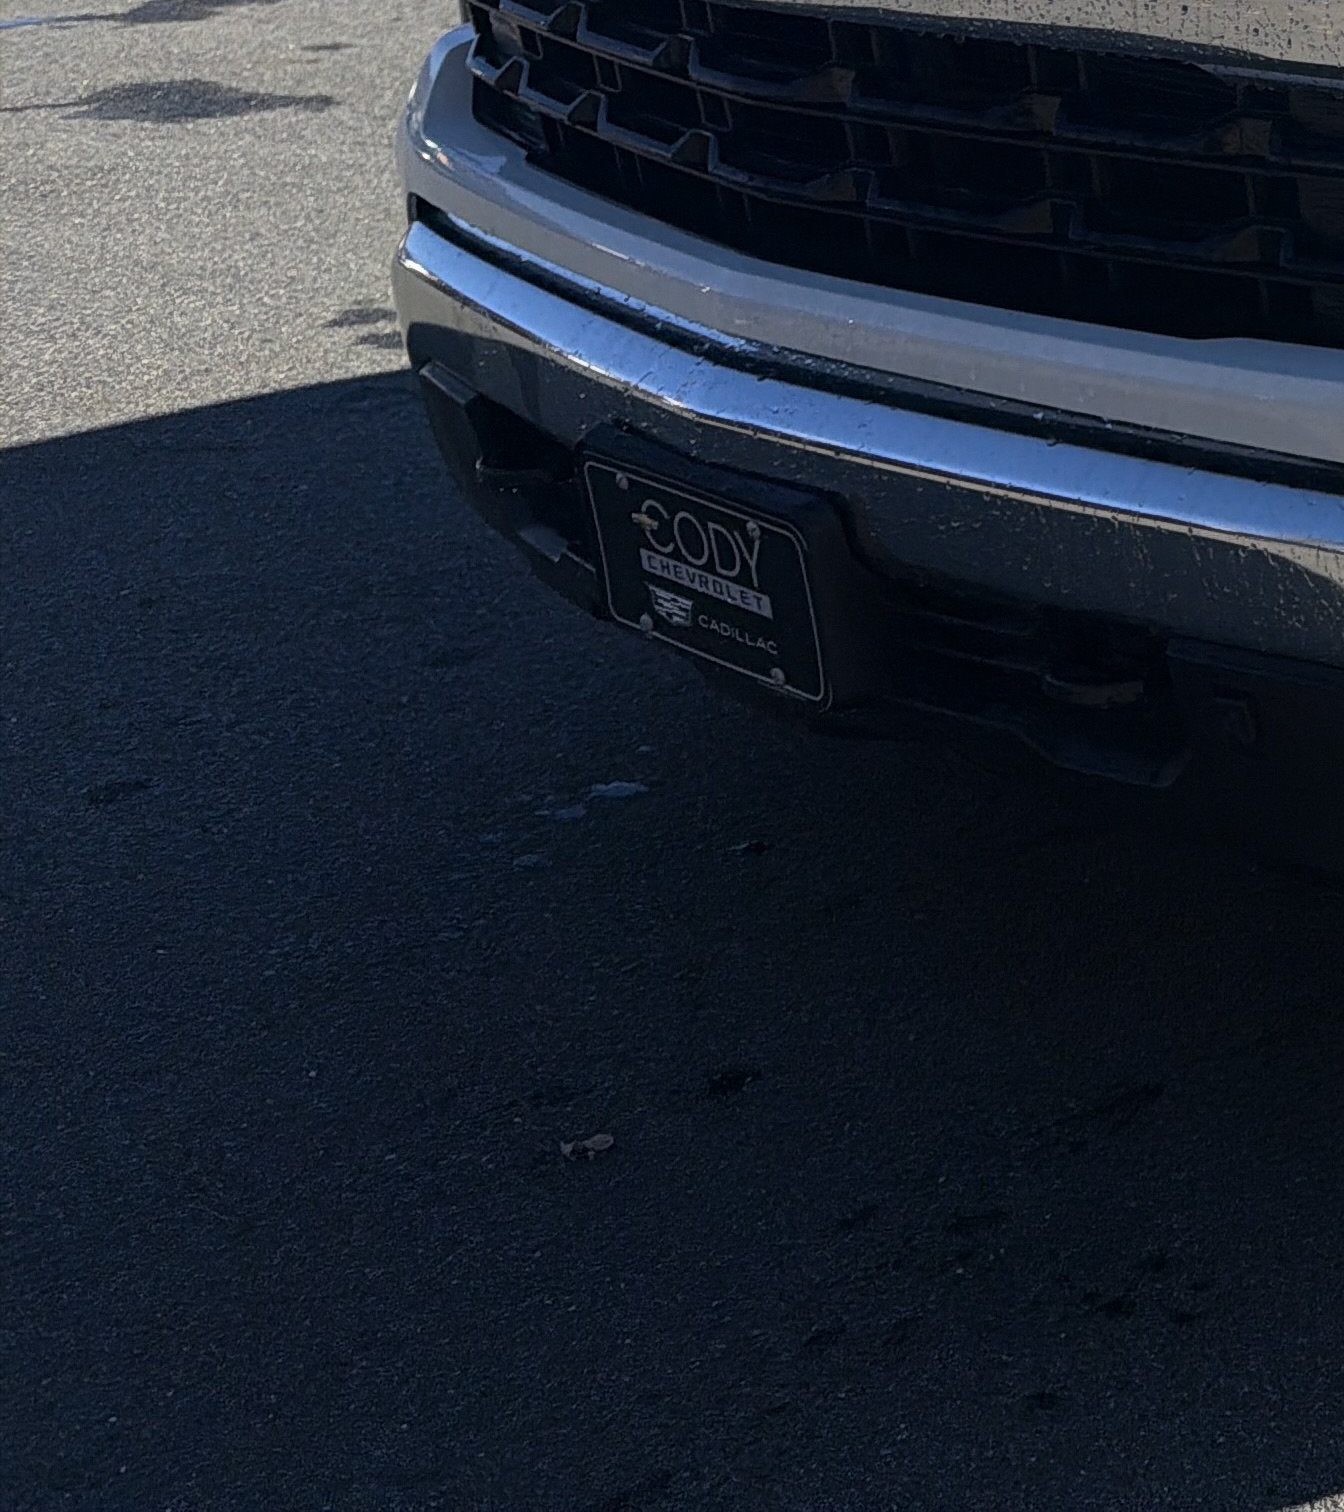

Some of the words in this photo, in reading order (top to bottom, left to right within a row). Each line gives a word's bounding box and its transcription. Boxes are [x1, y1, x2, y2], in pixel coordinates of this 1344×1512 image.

[639, 498, 760, 587] CODY
[645, 554, 766, 611] CHEVROLET
[698, 614, 779, 657] CADILLAC
